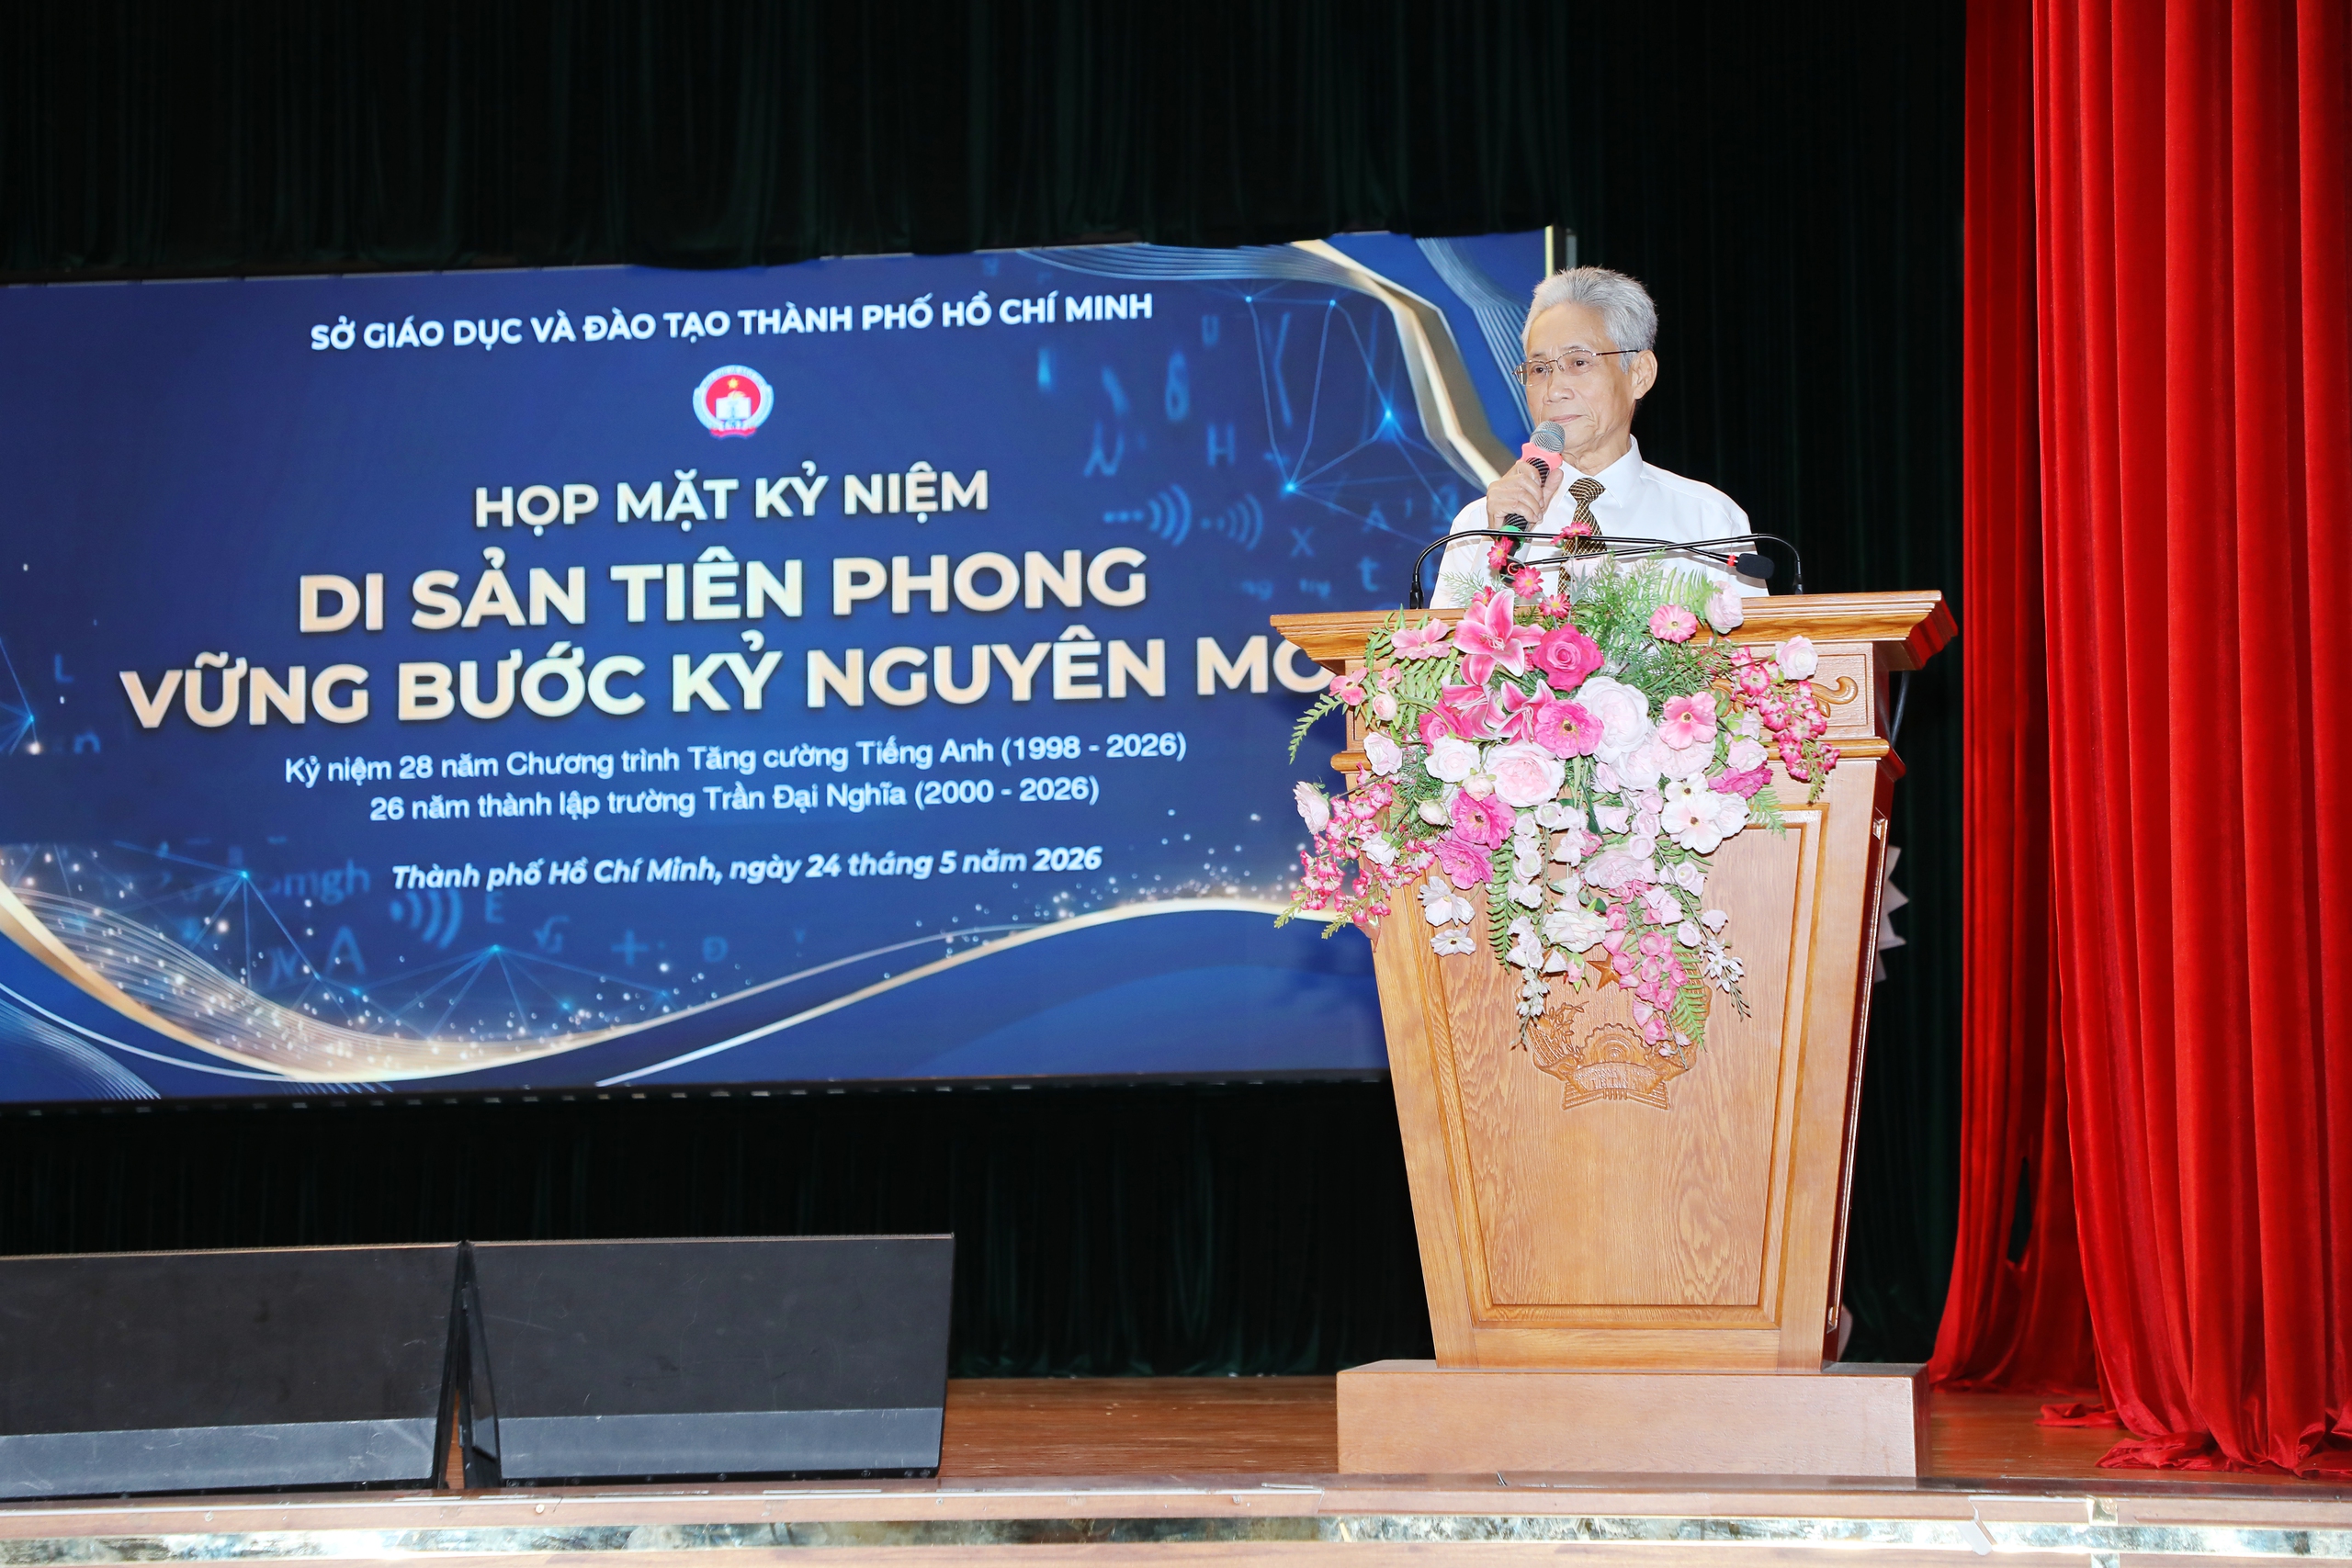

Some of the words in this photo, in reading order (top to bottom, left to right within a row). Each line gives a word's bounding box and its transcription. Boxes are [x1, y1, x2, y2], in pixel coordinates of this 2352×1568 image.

[311, 316, 356, 350] SỞ
[363, 316, 444, 349] GIÁO
[453, 318, 522, 351] DỤC
[530, 310, 576, 343] VÀ
[582, 308, 656, 341] ĐÀO
[662, 310, 730, 343] TẠO
[737, 302, 853, 335] THÀNH
[862, 293, 933, 331] PHỐ
[942, 291, 991, 327] HỒ
[999, 290, 1057, 325] CHÍ
[1065, 293, 1152, 321] MINH
[476, 484, 599, 536] HỌP
[616, 468, 739, 532] MẶT
[755, 460, 829, 518] KỶ
[844, 461, 989, 524] NIỆM
[300, 573, 384, 633] DI
[412, 547, 585, 630] SẢN
[610, 546, 802, 622] TIÊN
[832, 547, 1147, 615] PHONG
[119, 651, 368, 728] VỮNG
[398, 641, 645, 721] BƯỚC
[673, 629, 783, 712] KỶ
[807, 625, 1166, 708] NGUYÊN
[285, 755, 321, 789] Kỷ
[328, 756, 391, 786] niệm
[399, 755, 434, 780] 28
[441, 753, 499, 778] năm
[506, 750, 615, 780] Chương
[620, 747, 680, 773] trình
[686, 746, 756, 775] Tăng
[763, 743, 849, 773] cường
[855, 735, 933, 770] Tiếng
[939, 738, 994, 763] Anh
[1001, 735, 1081, 766] (1998
[1106, 732, 1186, 761] 2026)
[369, 796, 405, 821] 26
[412, 795, 470, 820] năm
[477, 792, 552, 818] thành
[560, 790, 601, 820] lập
[606, 788, 695, 818] trường
[702, 781, 765, 811] Trần
[772, 784, 819, 814] Đại
[826, 782, 907, 813] Nghĩa
[914, 779, 994, 810] (2000
[1019, 776, 1100, 806] 2026)
[392, 863, 481, 889] Thành
[486, 858, 544, 892] phố
[548, 857, 588, 885] Hồ
[594, 857, 643, 884] Chí
[646, 856, 723, 886] Minh,
[729, 854, 802, 885] ngày
[805, 853, 842, 878] 24
[847, 851, 934, 880] tháng
[938, 850, 957, 874] 5
[962, 848, 1027, 874] năm
[1032, 846, 1102, 872] 2026
